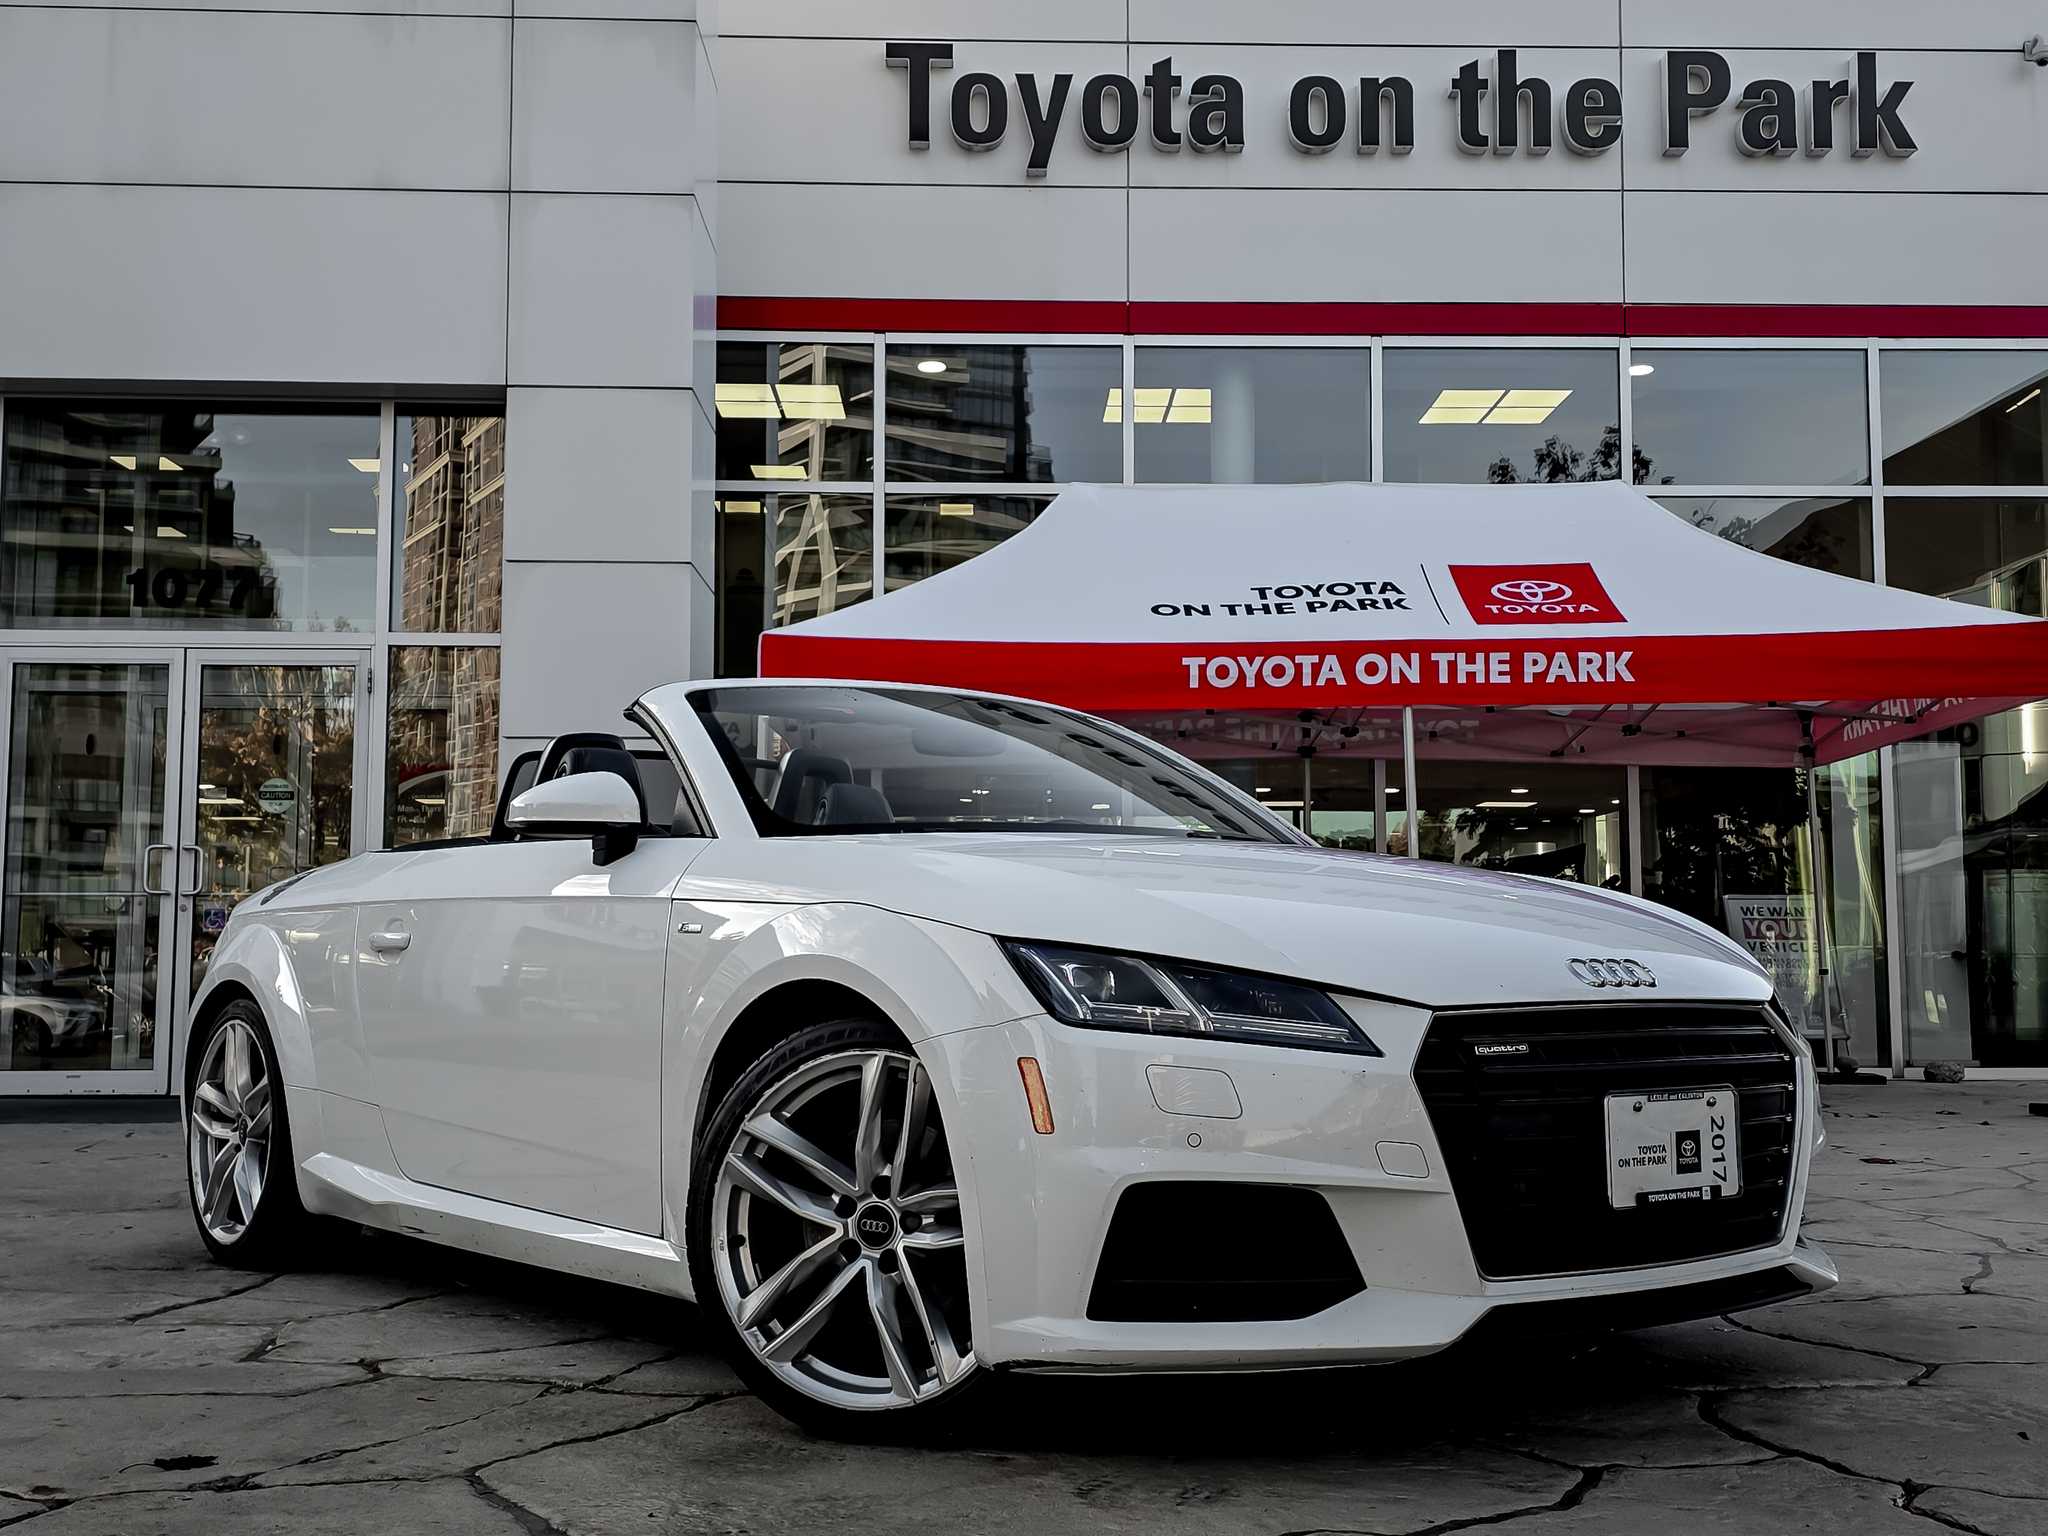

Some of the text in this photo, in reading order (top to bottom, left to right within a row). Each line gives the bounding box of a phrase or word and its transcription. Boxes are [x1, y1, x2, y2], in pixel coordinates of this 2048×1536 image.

[885, 42, 1919, 177] Toyota on the Park
[126, 567, 257, 609] 1077
[1250, 581, 1405, 600] TOYOTA
[1150, 597, 1412, 617] ON THE PARK
[1485, 603, 1599, 614] TOYOTA
[1182, 650, 1635, 688] TOYOTA ON THE PARK
[397, 826, 425, 835] Sunday
[1740, 906, 1813, 917] WE WANT
[1744, 919, 1814, 938] YOUR
[1479, 1045, 1526, 1054] quattro
[1650, 1093, 1668, 1101] LESLIE
[1638, 1144, 1667, 1155] TOYOTA
[1710, 1115, 1727, 1183] 2017
[1618, 1155, 1667, 1168] ON THE PARK
[1679, 1156, 1699, 1165] TOYOTA
[1648, 1194, 1668, 1202] TOYOTA
[1677, 1191, 1687, 1199] THE
[1687, 1190, 1700, 1198] PARK
